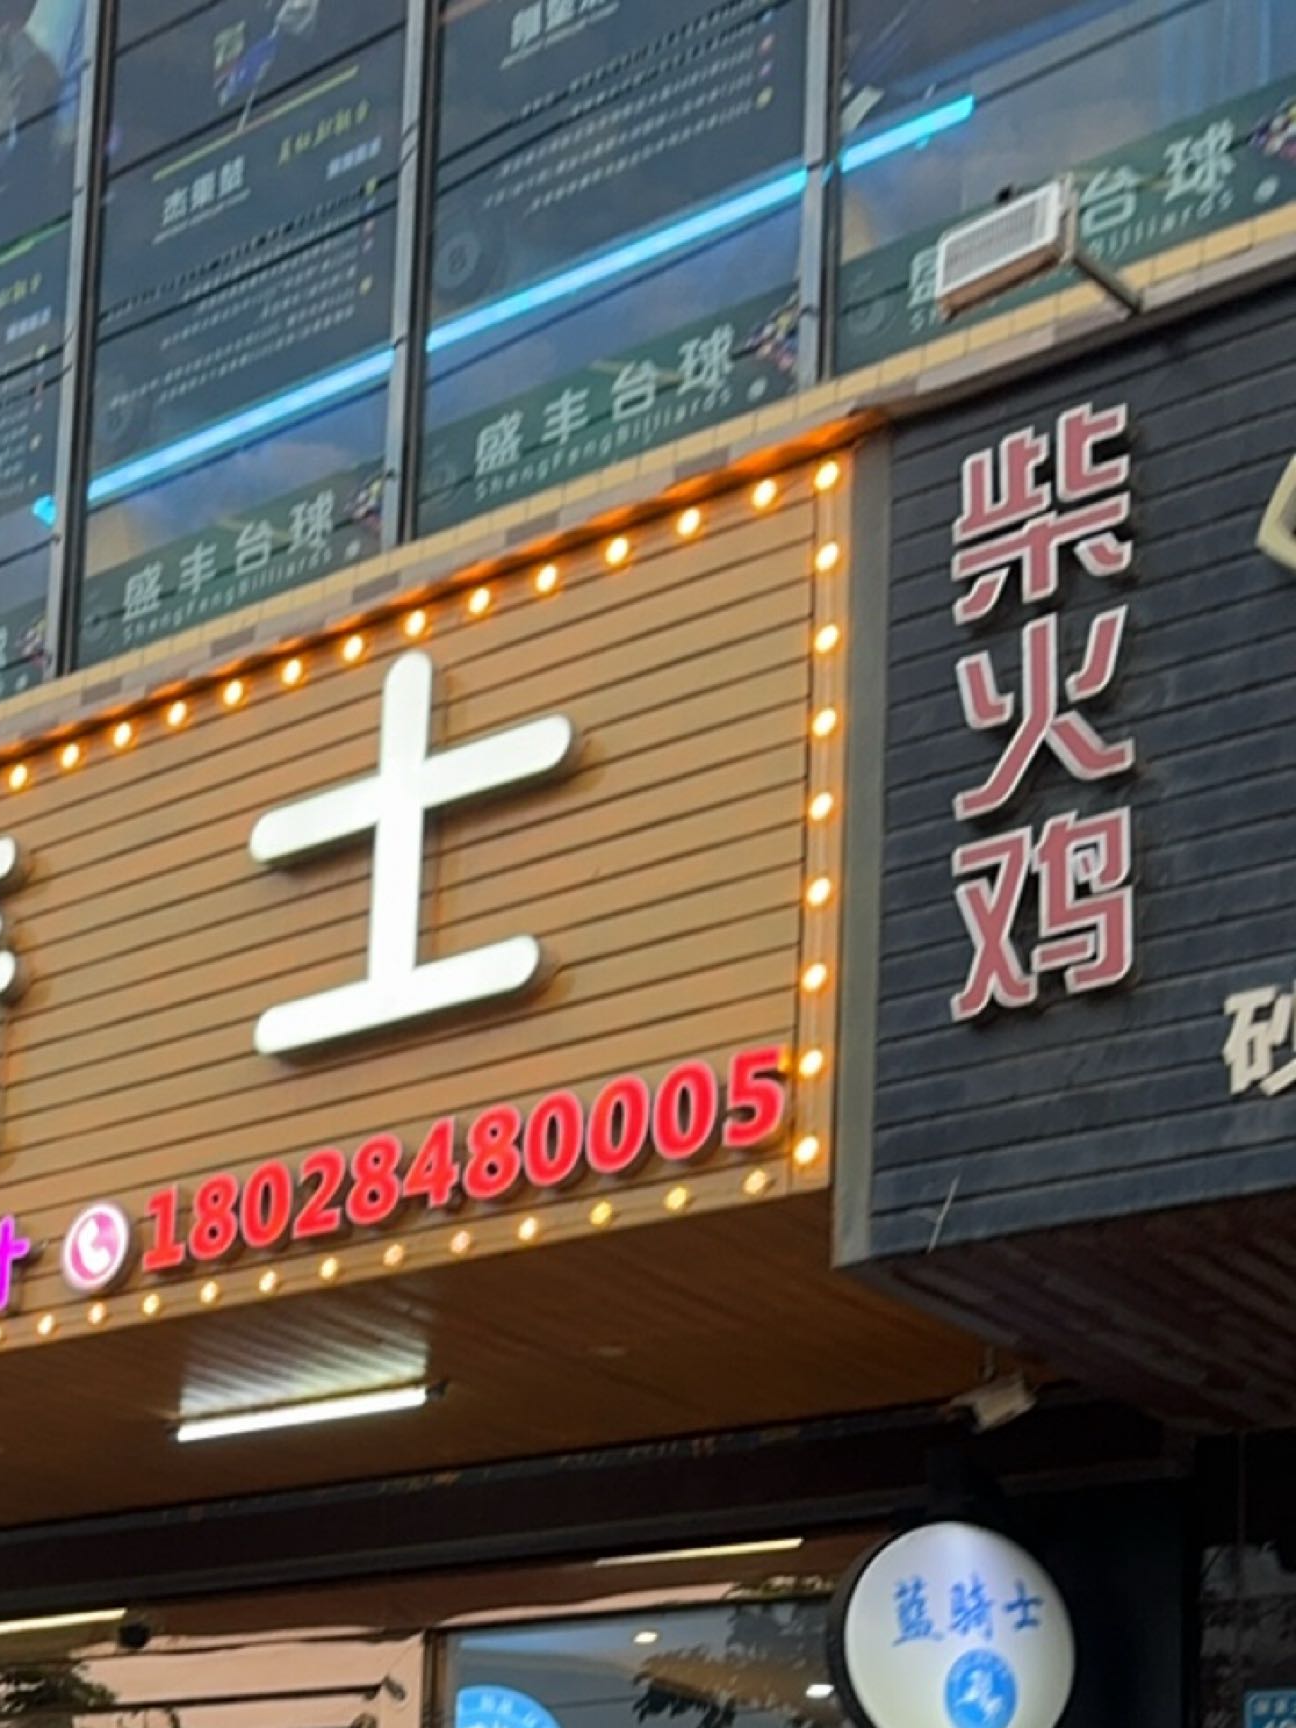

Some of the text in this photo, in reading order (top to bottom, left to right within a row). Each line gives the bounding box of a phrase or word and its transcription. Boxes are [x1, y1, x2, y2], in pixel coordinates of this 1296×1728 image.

[474, 323, 736, 477] 盛丰台球
[122, 489, 336, 622] 盛丰台球
[951, 402, 1135, 1023] 柴火鸡
[140, 1044, 789, 1272] 18028480005
[891, 1571, 1045, 1647] 蓝骑士
